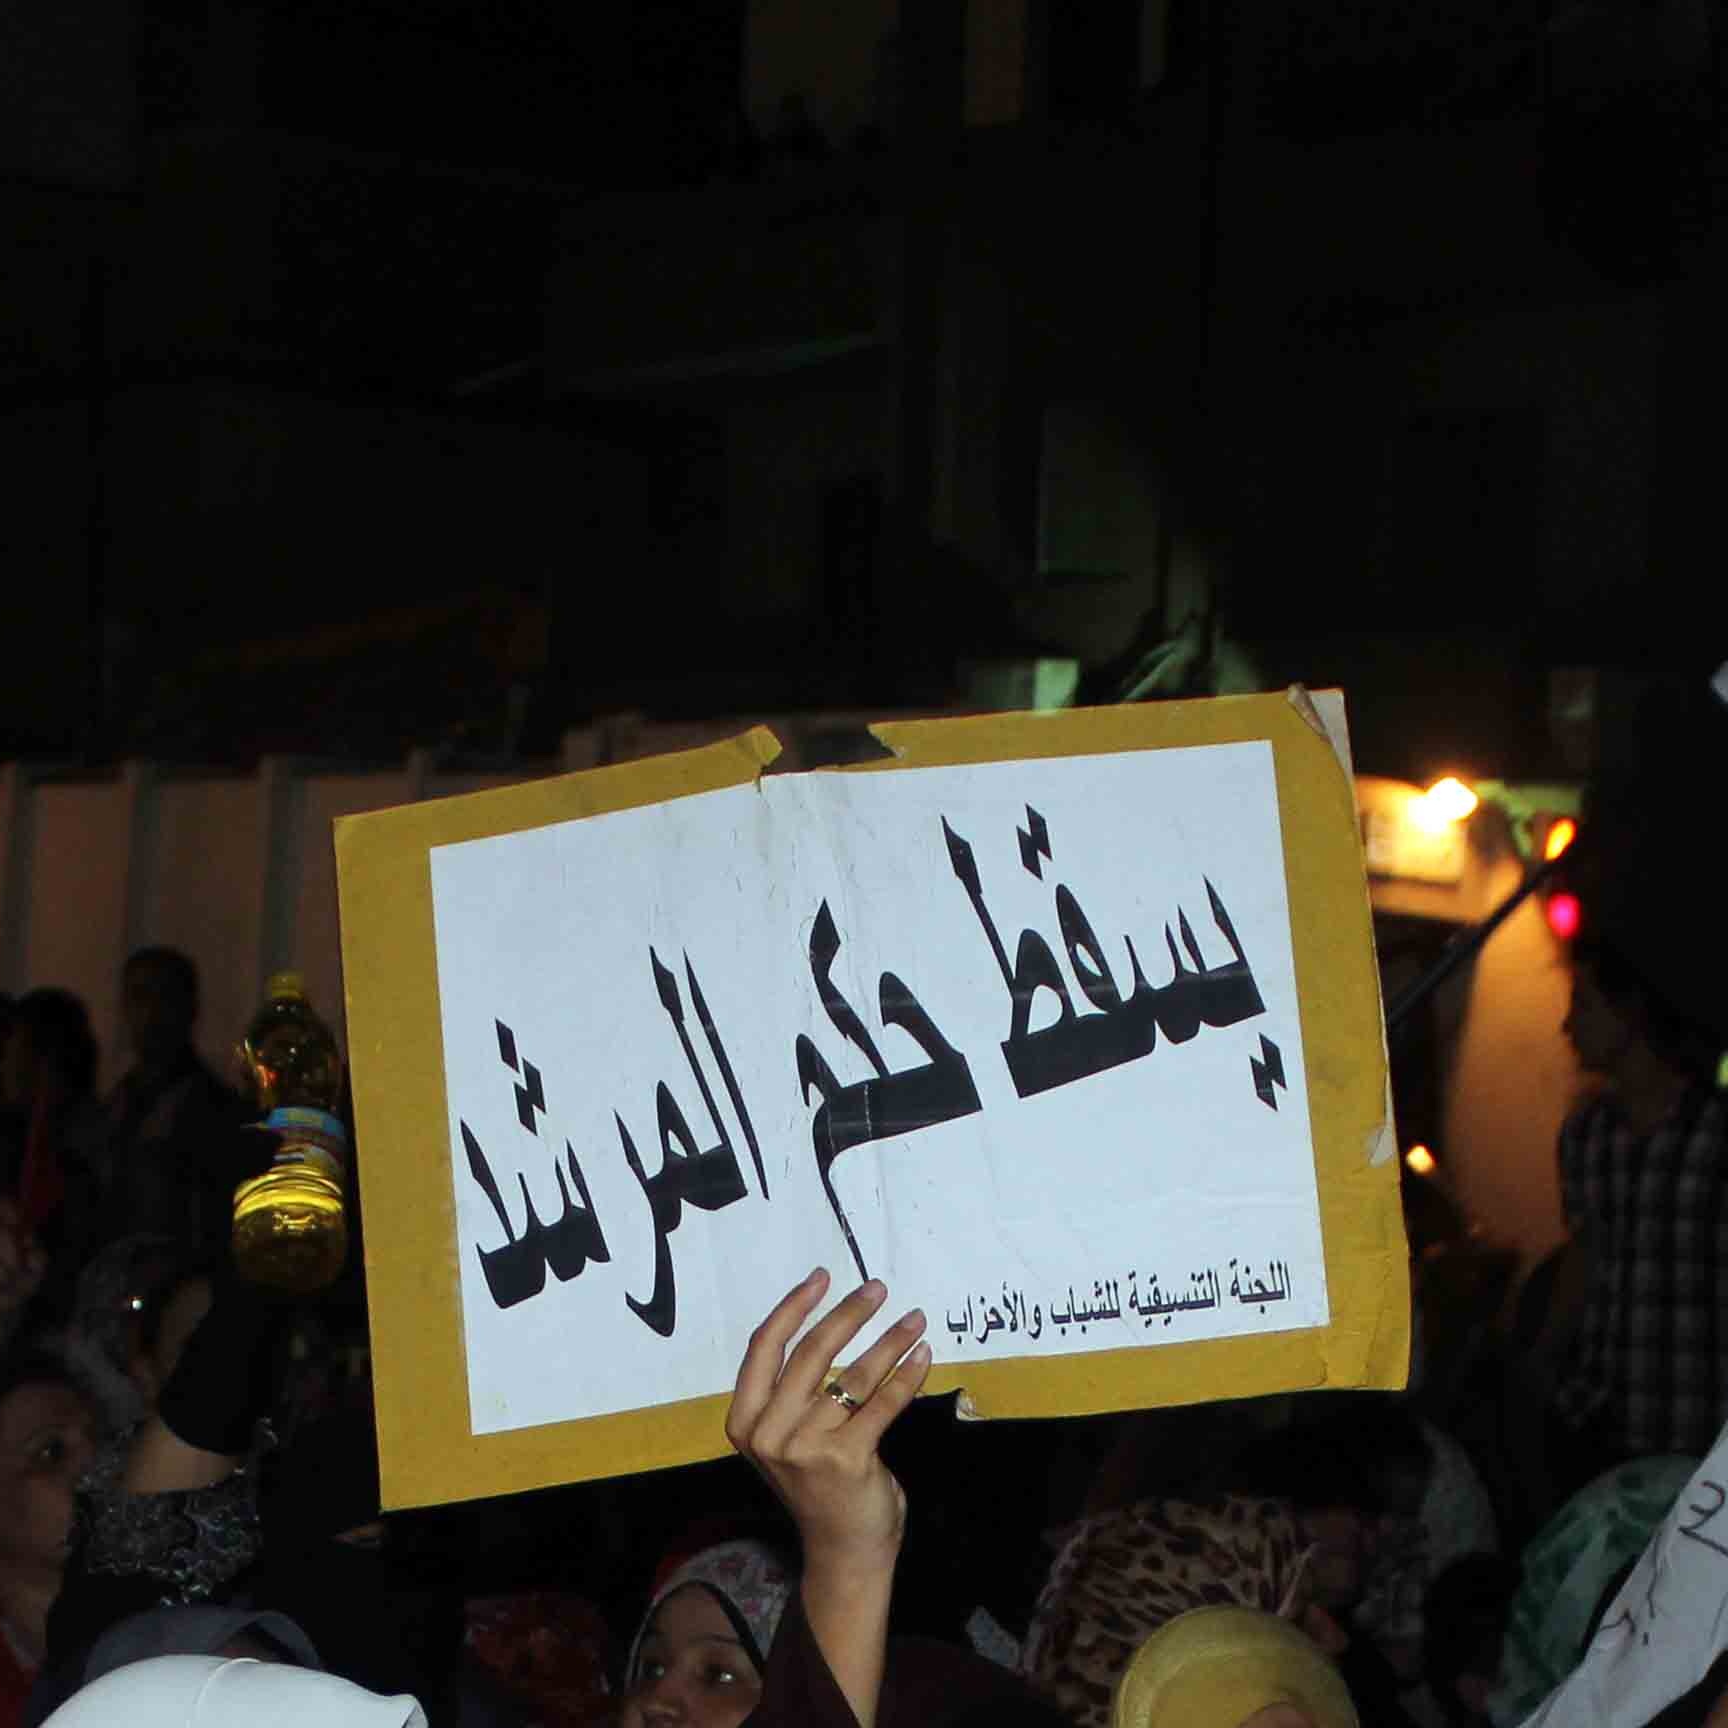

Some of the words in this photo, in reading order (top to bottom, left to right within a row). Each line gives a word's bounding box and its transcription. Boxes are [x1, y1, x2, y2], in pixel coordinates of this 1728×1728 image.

[939, 803, 1287, 1112] يسقط
[793, 897, 984, 1284] حكم
[459, 944, 771, 1338] المرشد
[945, 1280, 1043, 1345] والأحزاب
[1050, 1278, 1122, 1336] للشباب
[1127, 1266, 1221, 1329] التنسيقية
[1229, 1257, 1293, 1315] اللجنة
